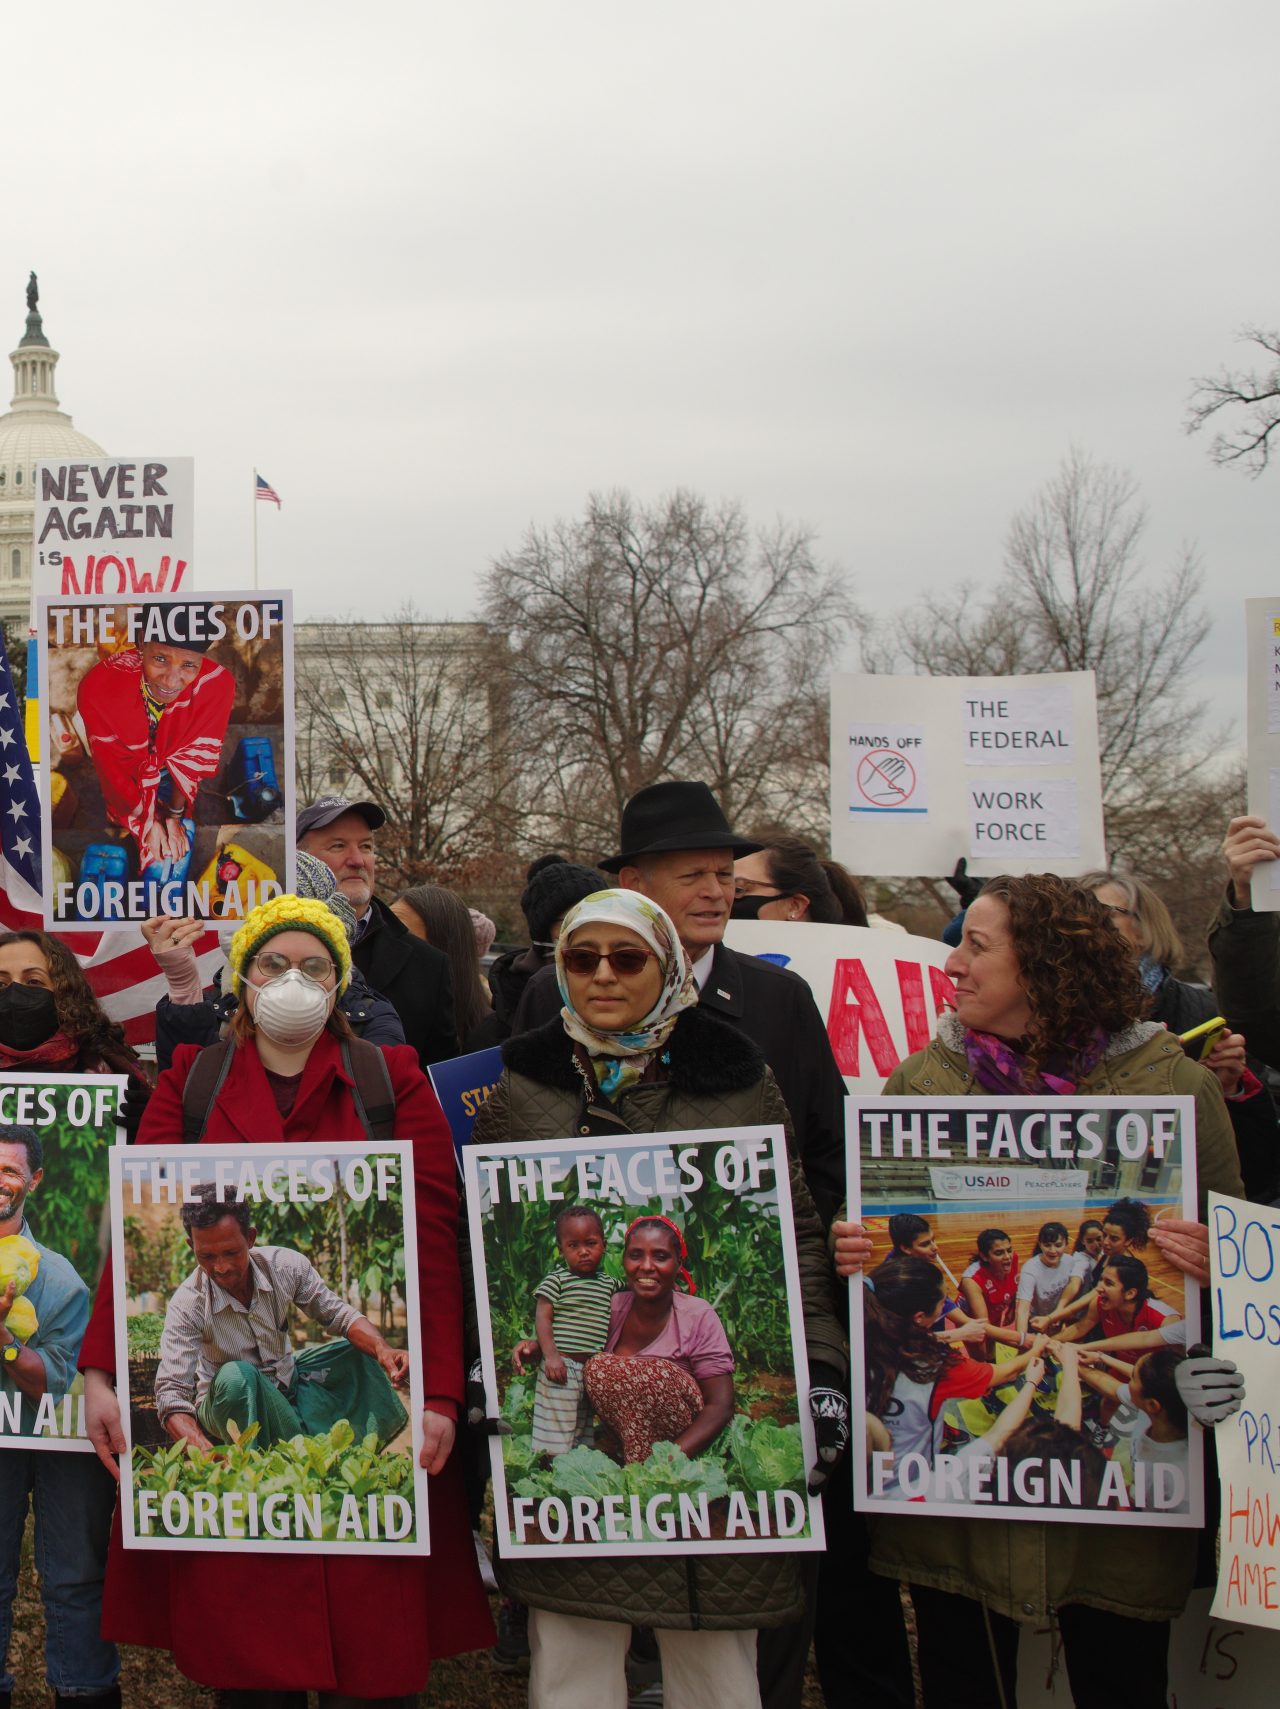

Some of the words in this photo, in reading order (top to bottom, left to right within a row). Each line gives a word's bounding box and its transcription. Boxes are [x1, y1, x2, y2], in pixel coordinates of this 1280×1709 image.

[41, 463, 168, 502] NEVER
[38, 504, 174, 544] AGAIN
[61, 555, 187, 595] NOW!
[50, 608, 115, 644] THE
[127, 604, 226, 643] FACES
[236, 604, 278, 641] OF
[966, 700, 1009, 718] THE
[849, 736, 889, 748] HANDS
[897, 737, 922, 748] OFF
[970, 729, 1069, 749] FEDERAL
[973, 792, 1044, 810] WORK
[976, 822, 1047, 841] FORCE
[58, 880, 210, 919] FOREIGN
[66, 1087, 113, 1127] OF
[862, 1112, 951, 1158] THE
[966, 1112, 1103, 1160] FACES
[1116, 1113, 1175, 1159] OF
[124, 1160, 203, 1204] THE
[215, 1158, 334, 1203] FACES
[345, 1157, 396, 1202] OF
[480, 1156, 564, 1204] THE
[576, 1148, 703, 1200] FACES
[714, 1144, 769, 1190] OF
[965, 1176, 1010, 1188] USAID
[872, 1450, 1081, 1505] FOREIGN
[1097, 1460, 1185, 1509] AID
[138, 1489, 321, 1538] FOREIGN
[337, 1494, 413, 1541] AID
[512, 1491, 711, 1543] FOREIGN
[726, 1489, 806, 1538] AID
